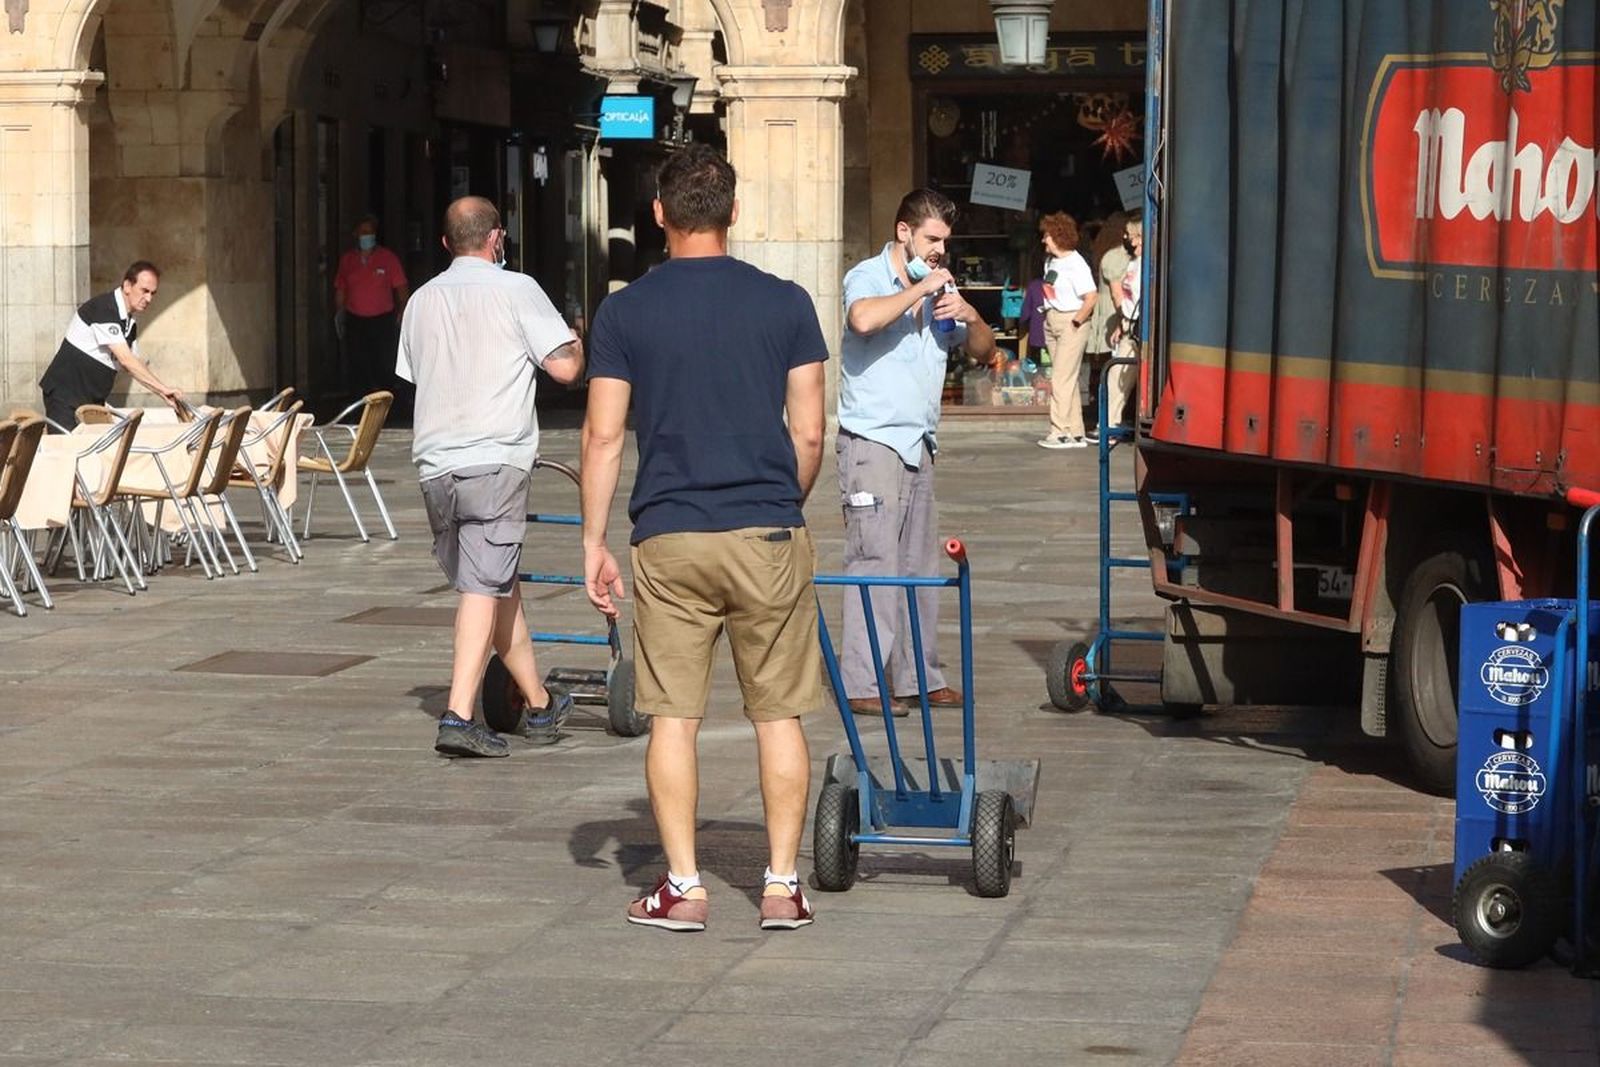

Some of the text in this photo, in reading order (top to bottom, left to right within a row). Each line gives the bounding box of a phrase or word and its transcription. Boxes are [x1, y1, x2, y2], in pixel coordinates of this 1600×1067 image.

[1414, 107, 1600, 224] Maho
[986, 171, 1017, 189] 20%
[1489, 667, 1541, 684] Mahou
[1484, 774, 1538, 792] Mahou
